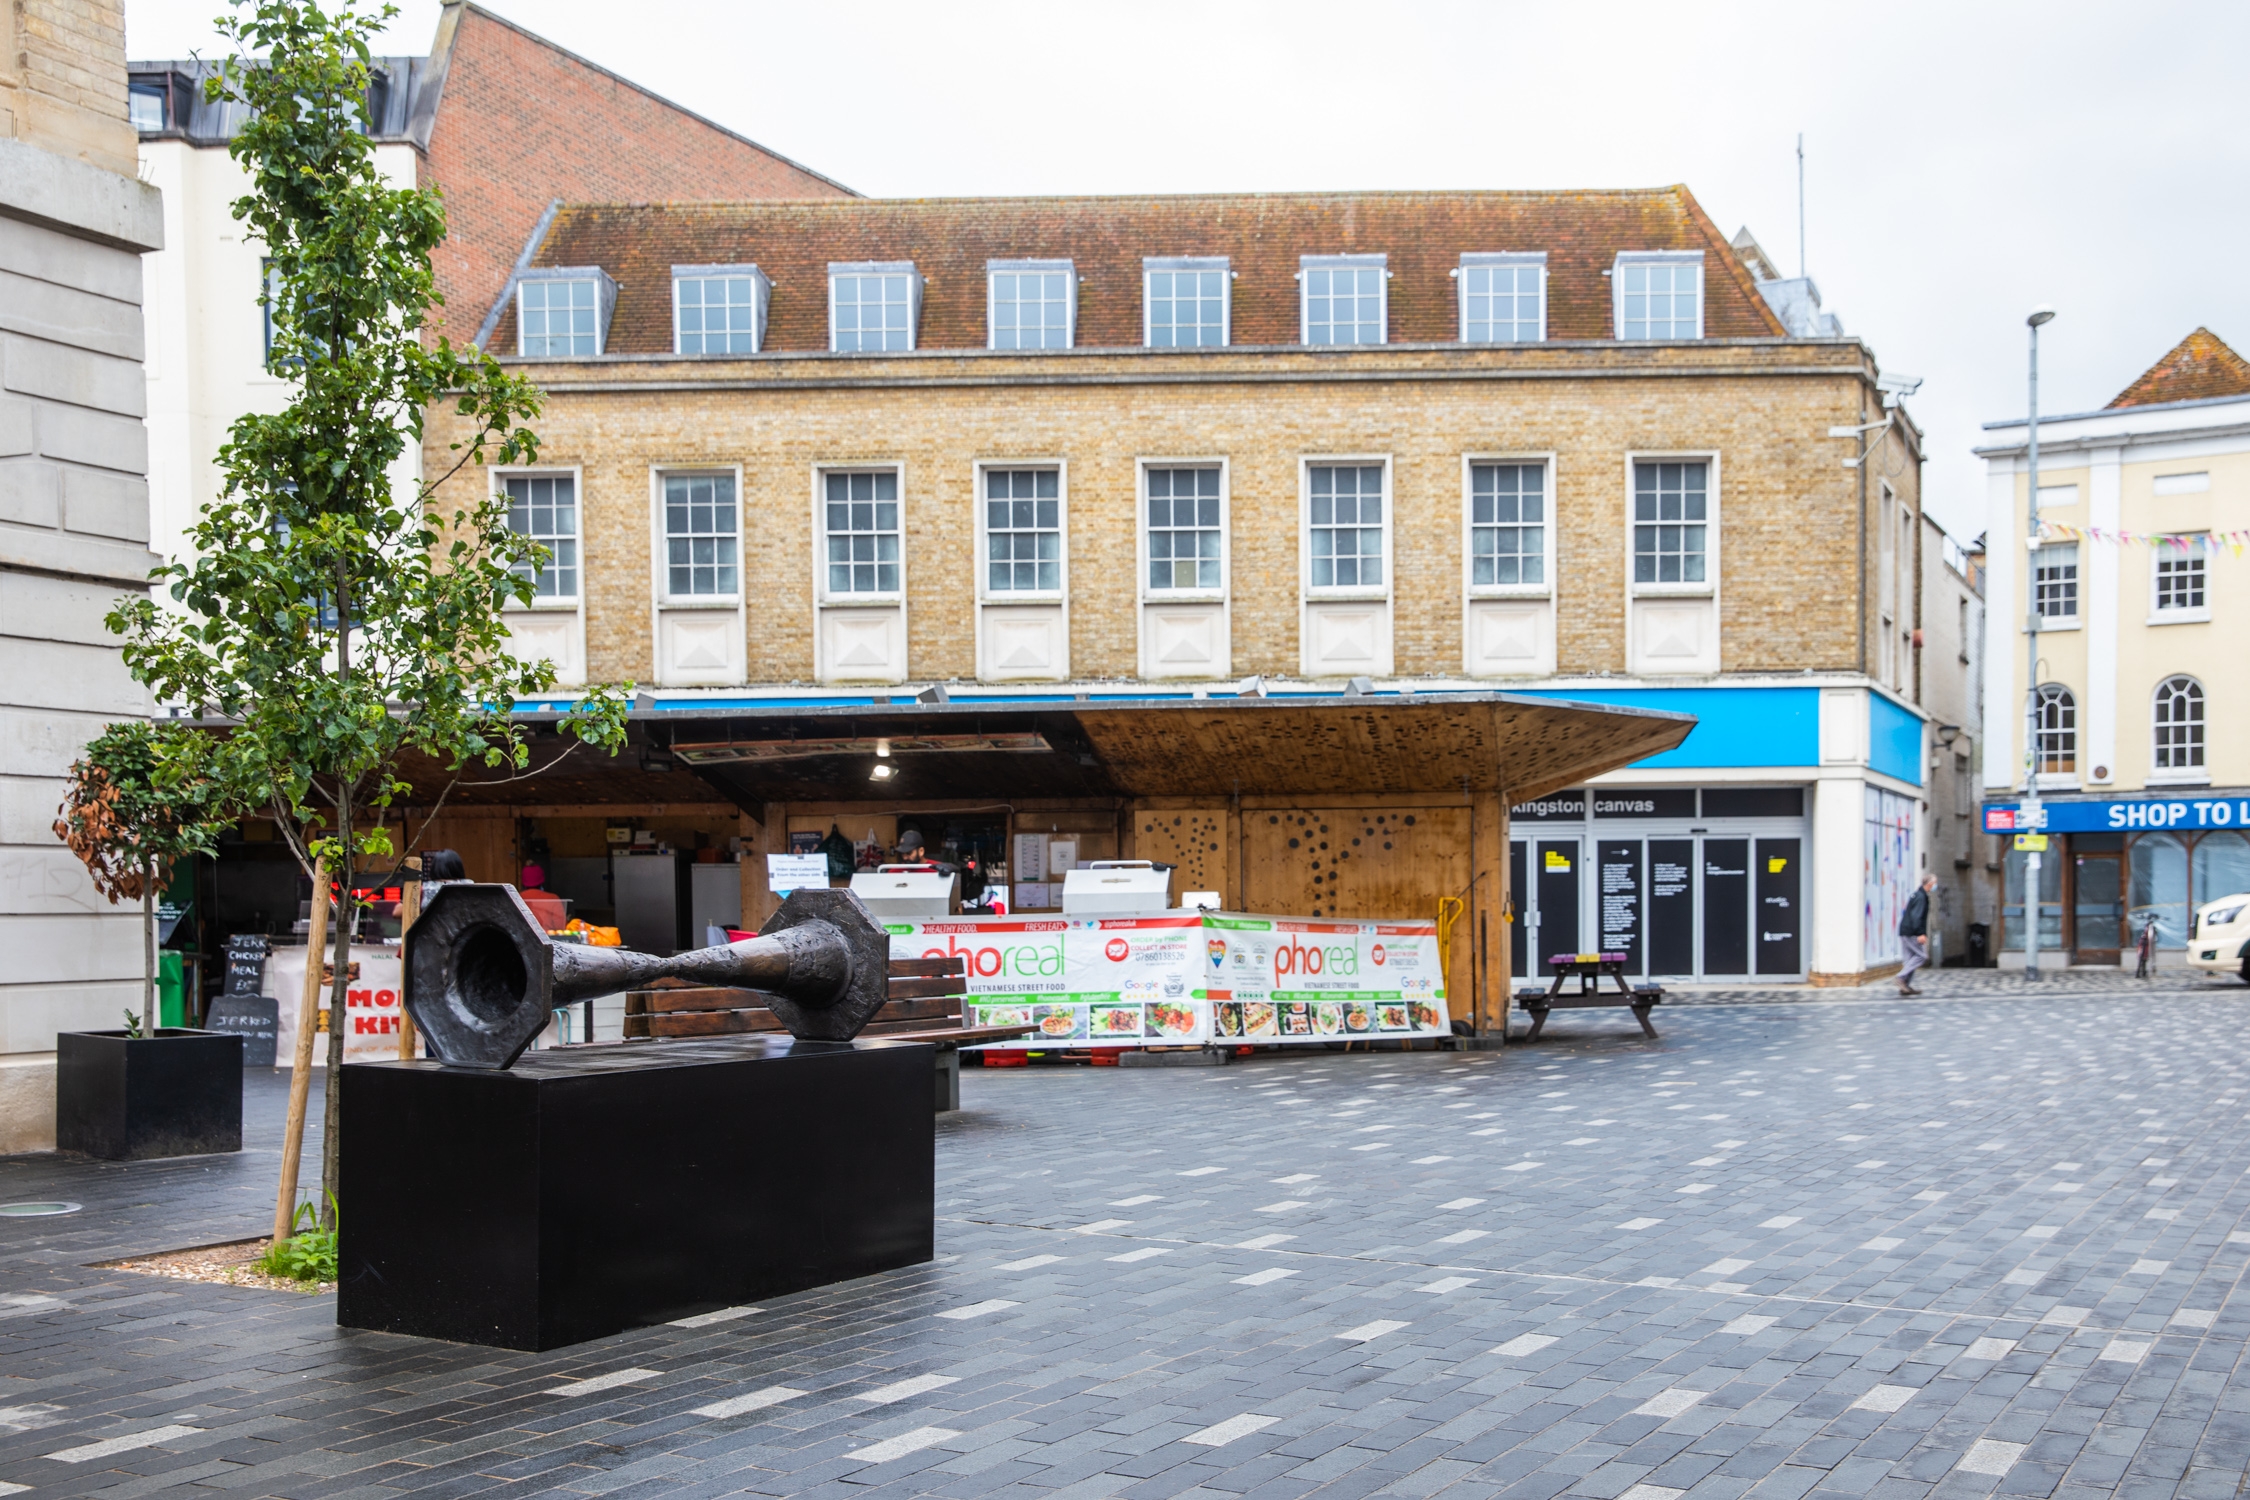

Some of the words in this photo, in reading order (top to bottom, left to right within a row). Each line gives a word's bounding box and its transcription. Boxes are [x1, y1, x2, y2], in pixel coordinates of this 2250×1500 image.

[1511, 799, 1585, 817] kingston
[1594, 799, 1655, 813] canvas
[2108, 803, 2188, 828] SHOP
[2193, 801, 2232, 826] TO
[925, 924, 957, 934] HEALTHY
[1024, 922, 1047, 931] FRESH
[233, 936, 266, 948] JERK
[229, 950, 265, 960] CHICKEN
[1274, 934, 1359, 988] phoreal
[231, 965, 259, 975] MEAL
[970, 984, 1017, 993] VIETNAMESE
[1017, 983, 1045, 992] STREET
[1046, 982, 1066, 991] FOOD
[1124, 979, 1159, 991] Google
[1401, 976, 1431, 990] Google
[348, 989, 400, 1007] MO
[355, 1016, 400, 1034] KIT
